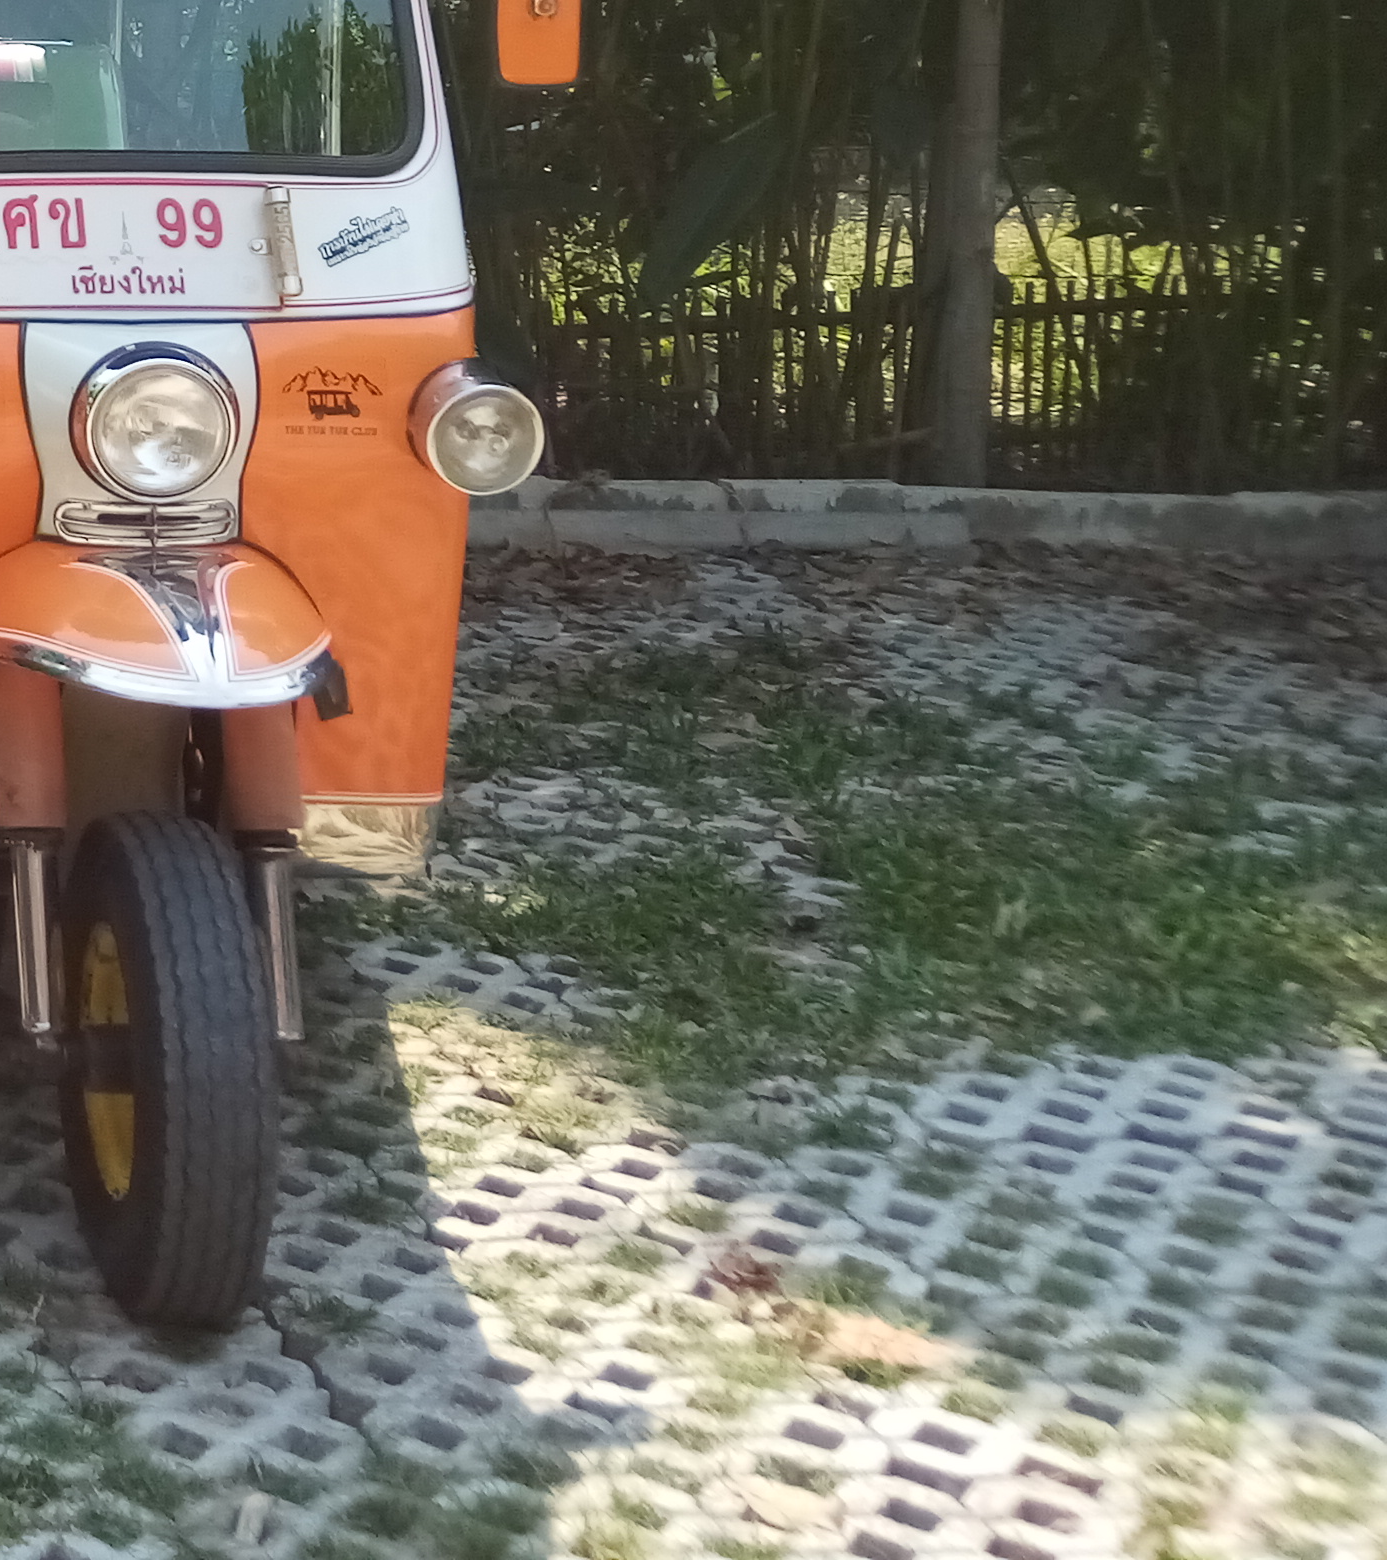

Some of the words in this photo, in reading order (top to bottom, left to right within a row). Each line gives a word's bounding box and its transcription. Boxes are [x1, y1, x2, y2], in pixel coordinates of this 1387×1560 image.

[3, 194, 86, 249] ศข
[156, 197, 223, 248] 99
[72, 265, 185, 294] เชียงใหม่
[285, 425, 305, 434] THE
[351, 427, 378, 436] CLUB
